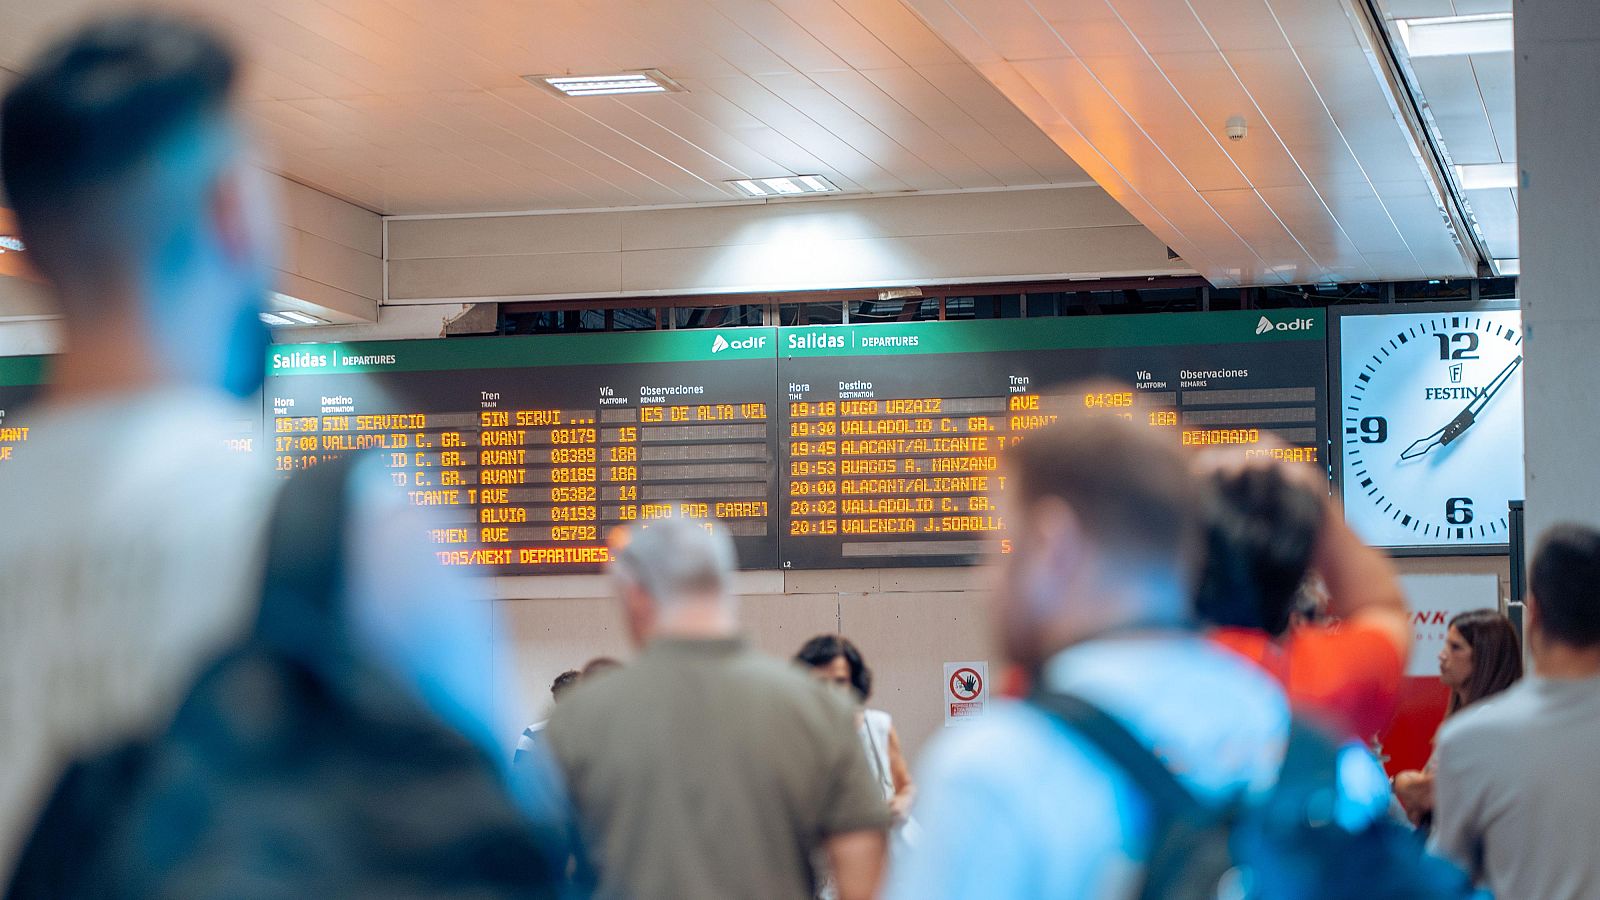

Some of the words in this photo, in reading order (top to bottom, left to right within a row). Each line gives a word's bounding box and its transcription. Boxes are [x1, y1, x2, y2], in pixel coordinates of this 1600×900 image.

[1276, 319, 1314, 331] adif
[789, 333, 845, 348] Salidas
[862, 336, 919, 347] DEPARTURES
[1433, 332, 1479, 360] 12
[274, 352, 326, 369] Salidas
[342, 355, 395, 366] DEPARTURES
[789, 383, 809, 392] Hora
[839, 381, 872, 390] Destino
[1009, 376, 1029, 385] Tren
[1136, 370, 1151, 380] Vía
[1180, 368, 1248, 379] Observaciones
[1136, 381, 1166, 389] PLATFORM
[274, 398, 295, 407] Hora
[321, 395, 352, 406] Destino
[481, 391, 500, 400] Tren
[600, 387, 613, 396] Vía
[640, 385, 704, 395] Observaciones
[1425, 387, 1488, 400] FESTINA
[791, 401, 835, 417] 19:18
[841, 400, 878, 415] VIGO
[1011, 395, 1039, 410] AVE
[322, 416, 348, 431] SIN
[357, 414, 425, 429] SERVICIO
[481, 412, 508, 426] SIN
[517, 411, 560, 425] SERVI
[641, 407, 662, 422] ES
[671, 406, 689, 421] DE
[698, 405, 734, 420] ALTA
[791, 421, 835, 437] 19:30
[841, 418, 932, 435] VALLADOLID
[941, 417, 958, 432] C.
[275, 436, 318, 451] 17:00
[323, 434, 407, 450] VALLADOLID
[416, 433, 431, 448] C.
[441, 432, 466, 448] GR.
[481, 431, 525, 446] AVANT
[551, 429, 596, 444] 08179
[619, 427, 636, 442] 15
[1360, 416, 1387, 443] 9
[791, 441, 835, 456] 19:45
[841, 437, 987, 454] ALACANT/ALICANTE
[1182, 429, 1259, 445] DEMORADO
[416, 453, 431, 467] C.
[481, 450, 525, 465] AVANT
[551, 448, 596, 463] 08389
[611, 447, 636, 462] 18A
[791, 461, 835, 476] 19:53
[842, 460, 896, 474] BURGOS
[932, 457, 996, 472] MANZANO
[416, 472, 431, 486] C.
[481, 469, 525, 484] AVANT
[551, 467, 596, 482] 08189
[611, 466, 636, 481] 18A
[468, 490, 476, 504] T
[481, 488, 508, 503] AVE
[551, 487, 596, 502] 05382
[619, 486, 636, 500] 14
[791, 481, 835, 496] 20:00
[841, 477, 987, 494] ALACANT/ALICANTE
[481, 508, 526, 523] ALVIA
[551, 506, 596, 521] 04193
[619, 505, 636, 520] 16
[681, 503, 707, 518] POR
[791, 501, 835, 515] 20:02
[842, 498, 932, 514] VALLADOLID
[942, 497, 959, 512] C.
[1446, 497, 1474, 525] 6
[481, 528, 508, 542] AVE
[551, 526, 596, 540] 05792
[791, 520, 836, 535] 20:15
[842, 518, 916, 534] VALENCIA
